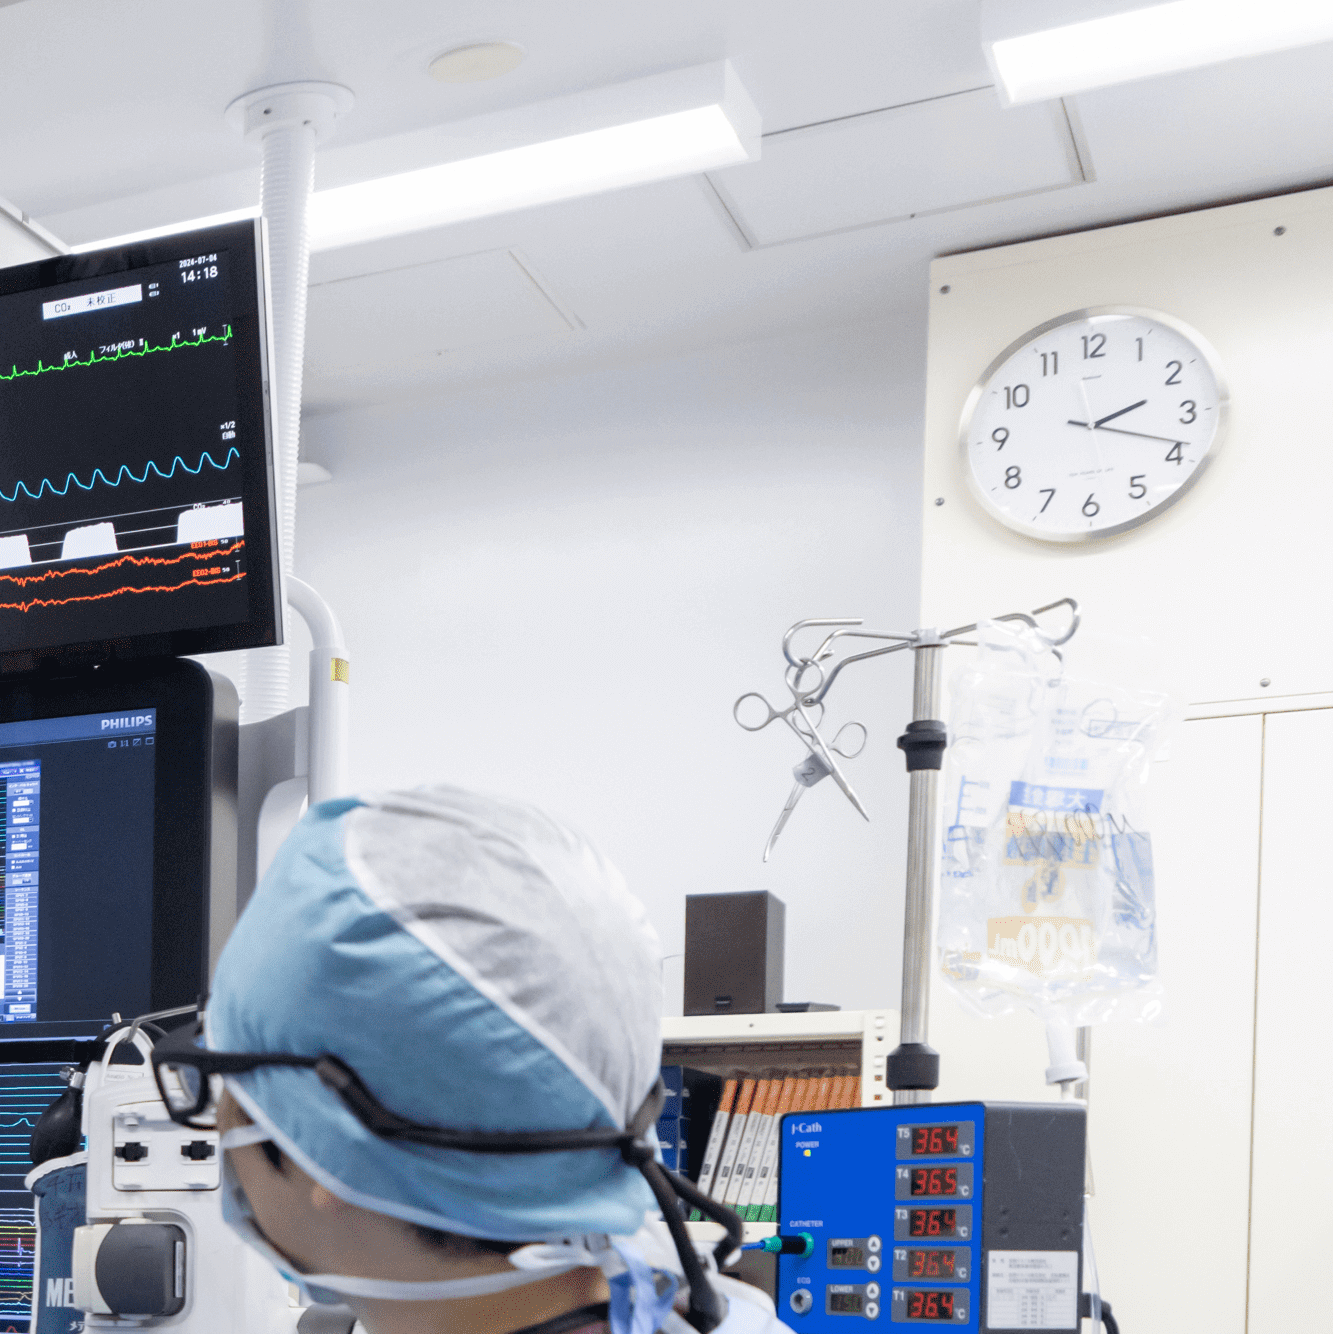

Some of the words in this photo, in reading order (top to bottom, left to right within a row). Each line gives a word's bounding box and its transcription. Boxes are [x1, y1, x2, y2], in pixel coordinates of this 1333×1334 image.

[179, 254, 218, 268] 2024-07-04
[181, 266, 218, 283] 14:18
[87, 293, 116, 307] 未校正
[1081, 333, 1107, 359] 12
[1135, 337, 1144, 362] 1
[1040, 351, 1059, 377] 11
[1164, 360, 1183, 386] 2
[1004, 384, 1031, 410] 10
[1178, 400, 1197, 425] 3
[991, 427, 1011, 451] 9
[1164, 441, 1183, 466] 4
[1004, 465, 1022, 489] 8
[1128, 474, 1147, 499] 5
[1039, 488, 1057, 513] 7
[1081, 493, 1100, 517] 6
[101, 715, 153, 730] PHILIPS
[897, 1128, 910, 1139] T5
[896, 1168, 909, 1179] T4
[789, 1220, 823, 1228] CATHETER
[895, 1209, 908, 1220] T3
[832, 1239, 853, 1247] UPPER
[894, 1249, 907, 1261] T2
[831, 1285, 853, 1293] LOWER
[893, 1290, 905, 1301] T1
